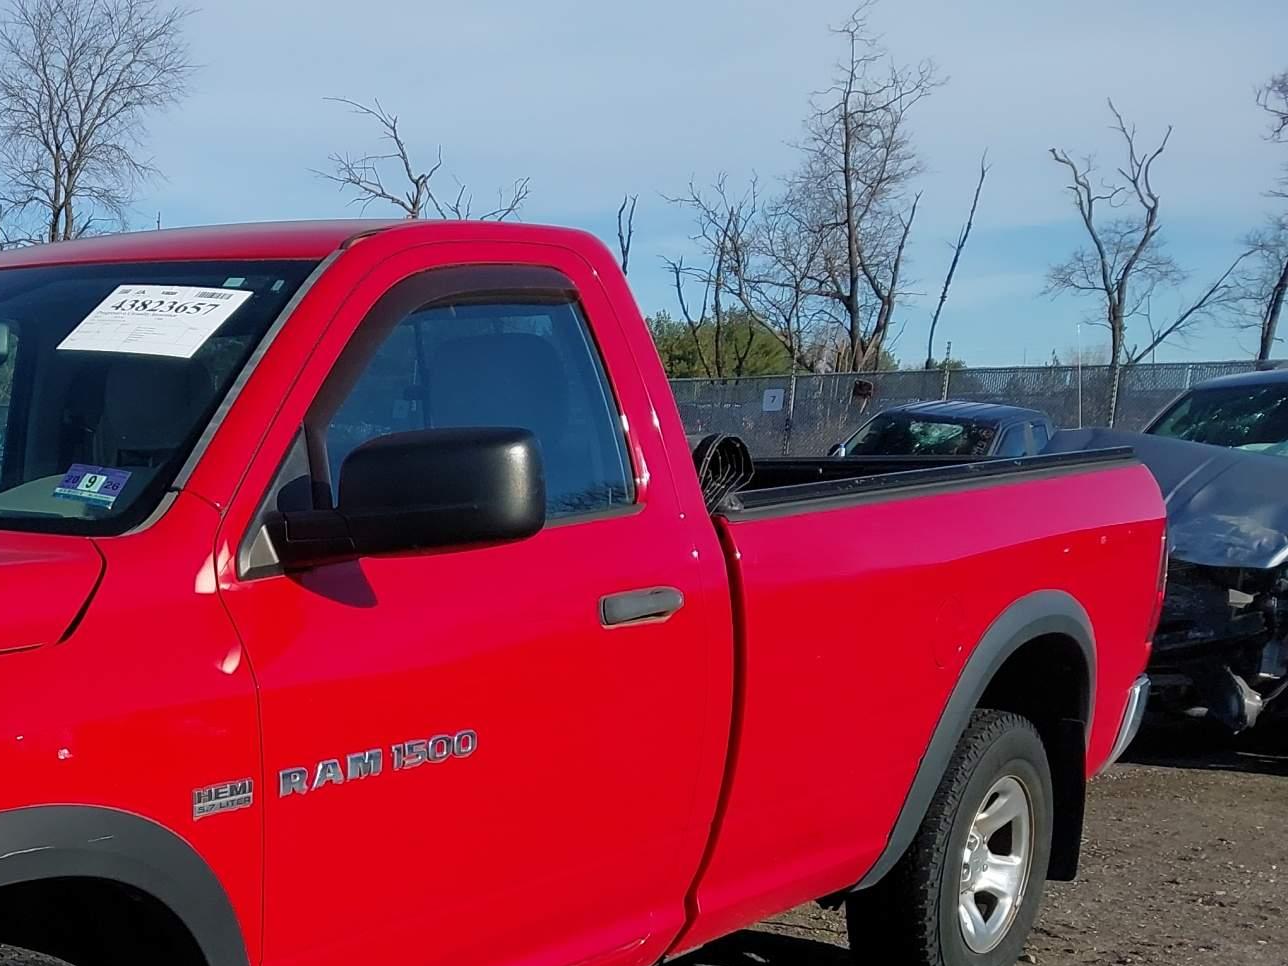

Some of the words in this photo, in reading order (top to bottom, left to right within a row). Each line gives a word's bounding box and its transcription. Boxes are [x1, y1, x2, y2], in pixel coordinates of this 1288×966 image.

[111, 299, 220, 316] 43823657
[85, 475, 98, 489] 9
[104, 480, 121, 491] 26
[278, 748, 384, 798] RAM
[391, 729, 479, 771] 1500
[195, 778, 253, 803] HEMI
[196, 803, 216, 815] 5.7
[219, 795, 251, 811] LITER
